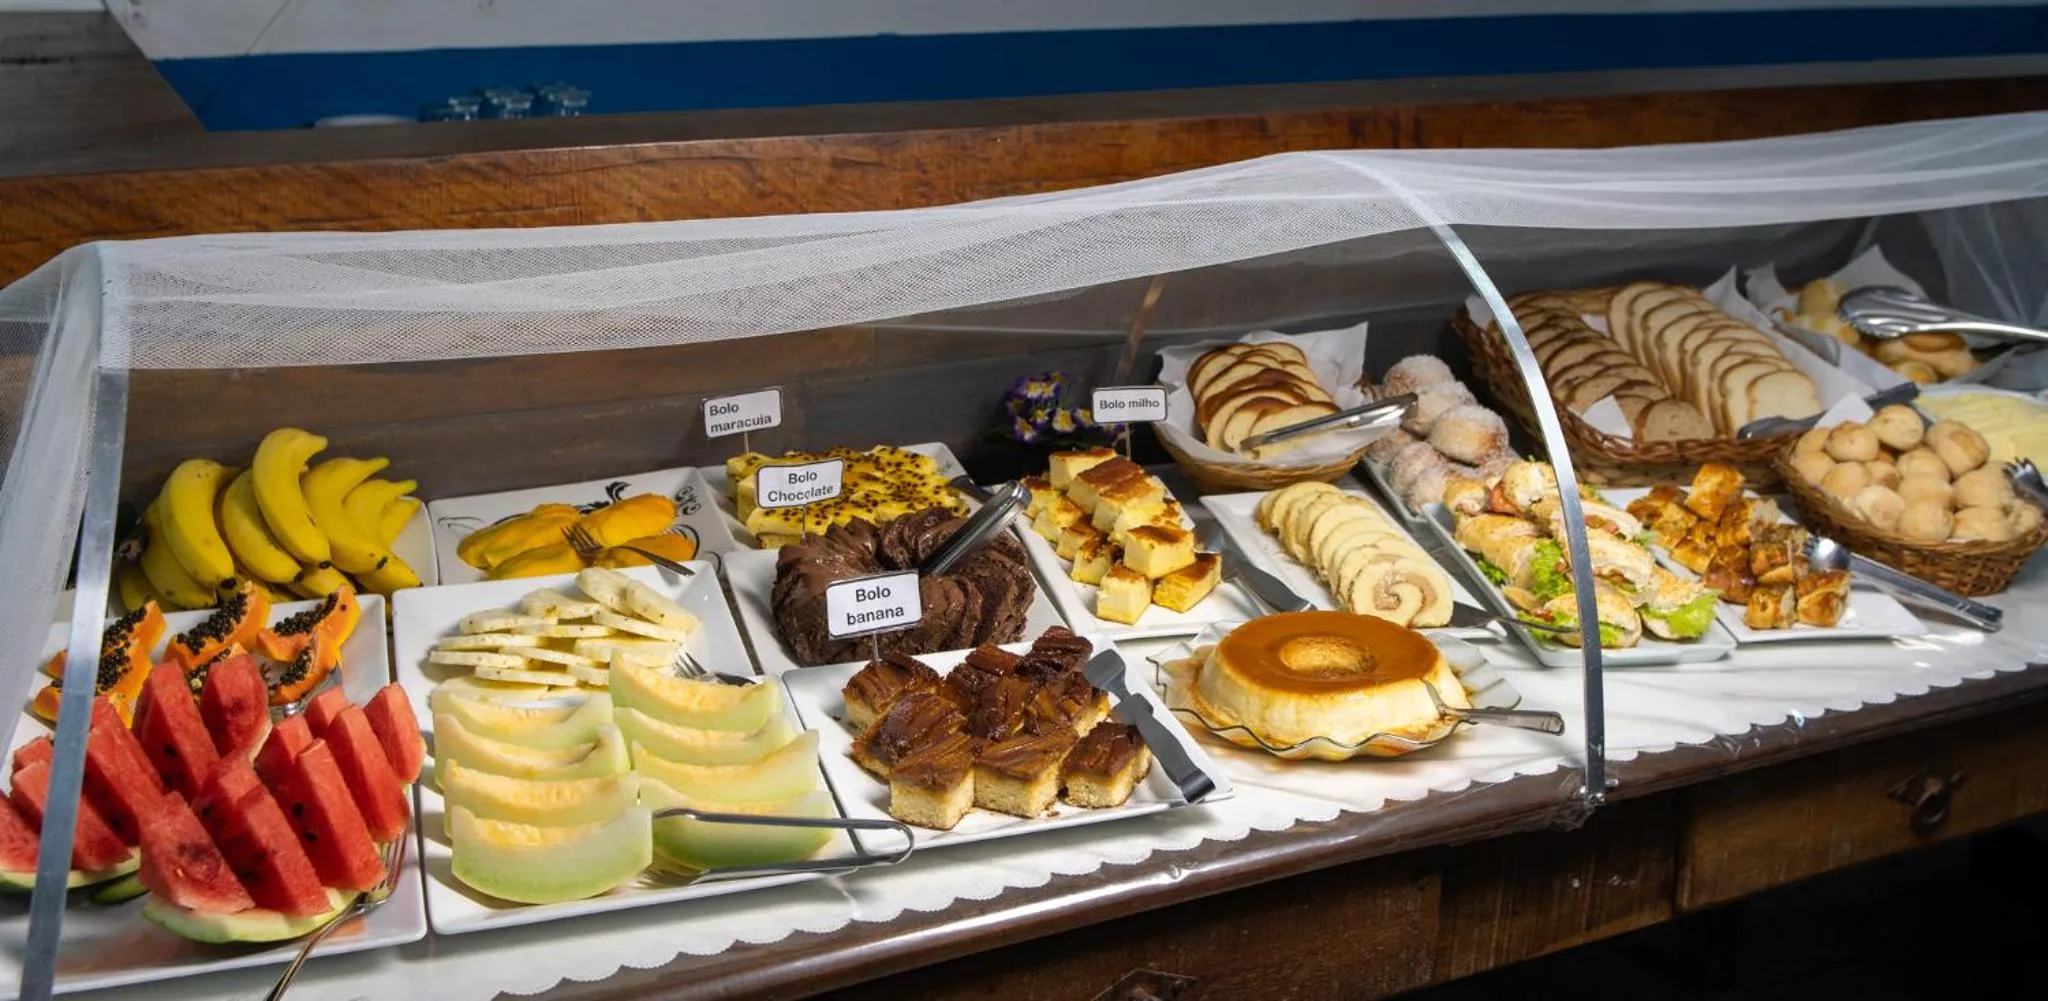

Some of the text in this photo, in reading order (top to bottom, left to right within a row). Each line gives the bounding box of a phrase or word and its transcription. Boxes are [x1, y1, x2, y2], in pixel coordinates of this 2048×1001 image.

[709, 403, 739, 416] Bolo
[1100, 398, 1160, 409] Bolo milho
[788, 471, 818, 485] Bolo
[767, 485, 834, 502] Chocolate
[855, 586, 891, 602] Bolo
[846, 606, 905, 626] banana
